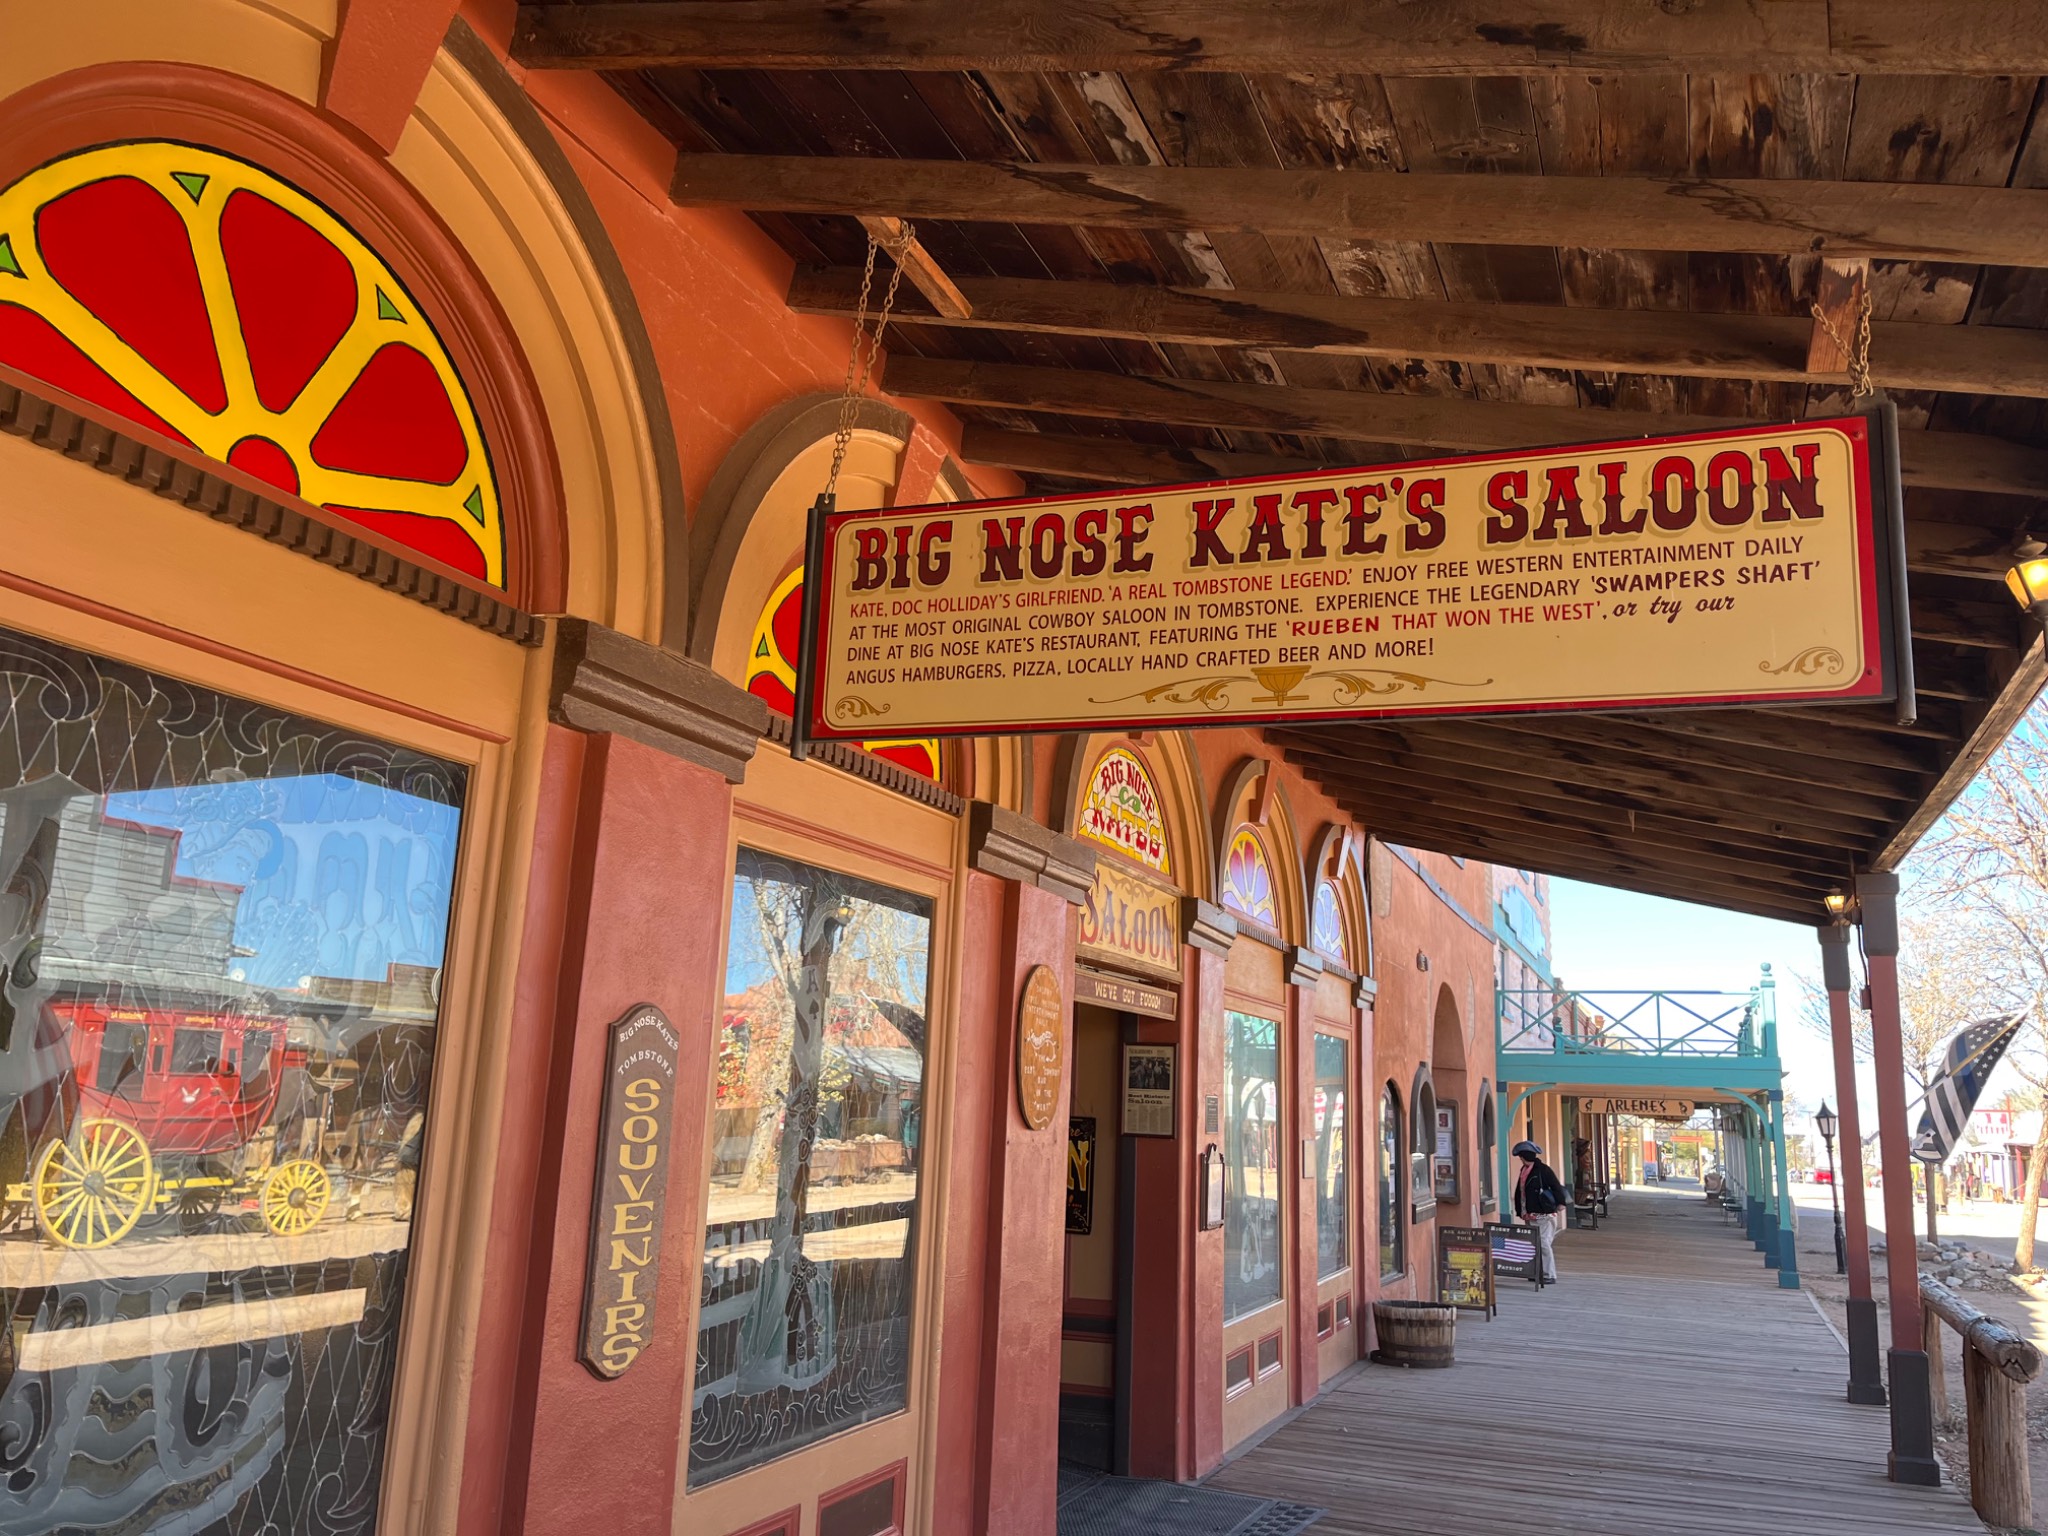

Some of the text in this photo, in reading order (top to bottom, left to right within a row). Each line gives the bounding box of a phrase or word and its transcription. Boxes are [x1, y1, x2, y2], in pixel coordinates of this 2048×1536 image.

[851, 443, 1824, 591] BIG NOSE KATE'S SALOON
[850, 602, 888, 618] KATE,
[892, 600, 923, 616] DOC
[927, 593, 1010, 613] HOLLIDAY'S
[1129, 583, 1167, 600] REAL
[1173, 575, 1273, 597] TOMBSTONE
[1362, 564, 1418, 584] ENJOY
[1426, 561, 1468, 580] FREE
[1476, 554, 1563, 576] WESTERN
[1573, 541, 1735, 569] ENTERTAINMENT
[1745, 536, 1804, 557] DAILY
[847, 646, 880, 661] DINE
[887, 645, 904, 660] AT
[910, 642, 934, 658] BIG
[941, 640, 980, 657] NOSE
[986, 637, 1035, 654] KATE'S
[1041, 631, 1141, 651] RESTAURANT,
[1150, 625, 1238, 645] FEATURING
[1245, 623, 1277, 639] THE
[1392, 612, 1438, 631] THAT
[1445, 609, 1491, 627] WON
[1499, 606, 1534, 624] THE
[1649, 595, 1682, 624] try
[1695, 596, 1735, 612] our
[849, 626, 867, 640] AT
[872, 624, 899, 639] THE
[904, 621, 946, 637] MOST
[952, 616, 1022, 635] ORIGINAL
[1028, 611, 1096, 630] COWBOY
[1102, 607, 1166, 625] SALOON
[1174, 605, 1190, 621] IN
[1198, 597, 1303, 620] TOMBSTONE.
[1316, 589, 1419, 612] EXPERIENCE
[1427, 587, 1462, 605] THE
[1470, 578, 1580, 602] LEGENDARY
[846, 638, 1434, 685] ANGUS HAMBURGERS, PIZZA, LOCALLY HAND CRAFTED BEER AND MORE!
[1101, 760, 1155, 821] BIG NOSE
[1081, 869, 1176, 965] SALOON
[1123, 988, 1135, 1005] GOT
[617, 1049, 674, 1078] TOMBSTONE
[619, 1015, 679, 1051] BIG NOSE KATES
[1606, 1099, 1666, 1112] ARLENE'S
[602, 1077, 662, 1371] SOUVENIRS
